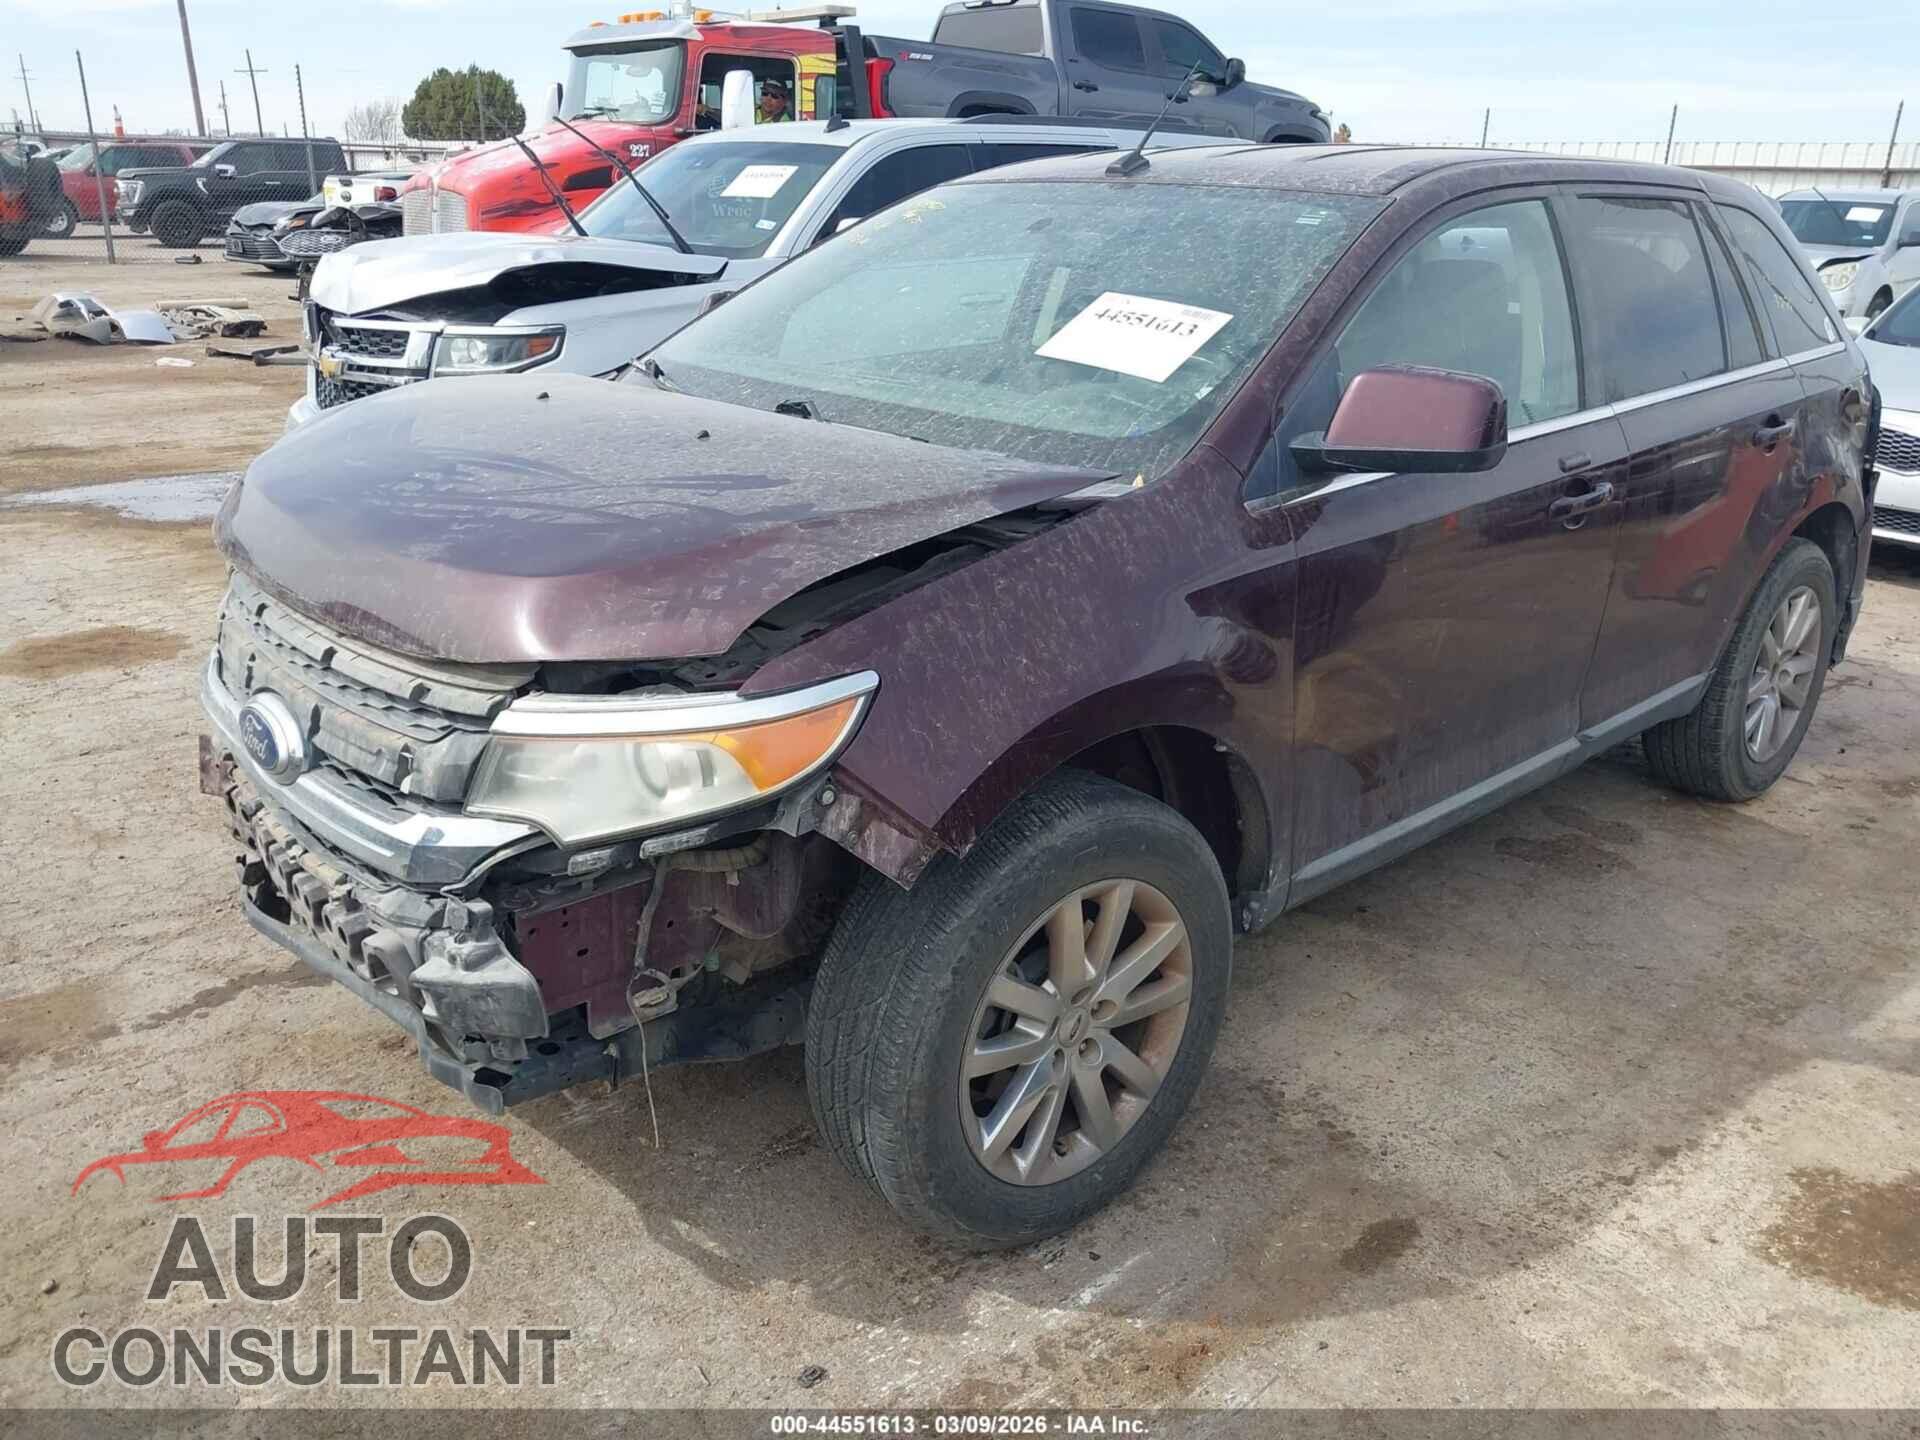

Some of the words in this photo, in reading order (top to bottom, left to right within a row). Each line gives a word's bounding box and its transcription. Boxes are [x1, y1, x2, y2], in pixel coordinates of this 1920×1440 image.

[629, 143, 649, 157] 227
[1095, 307, 1199, 337] 44551613
[244, 713, 270, 761] Ford
